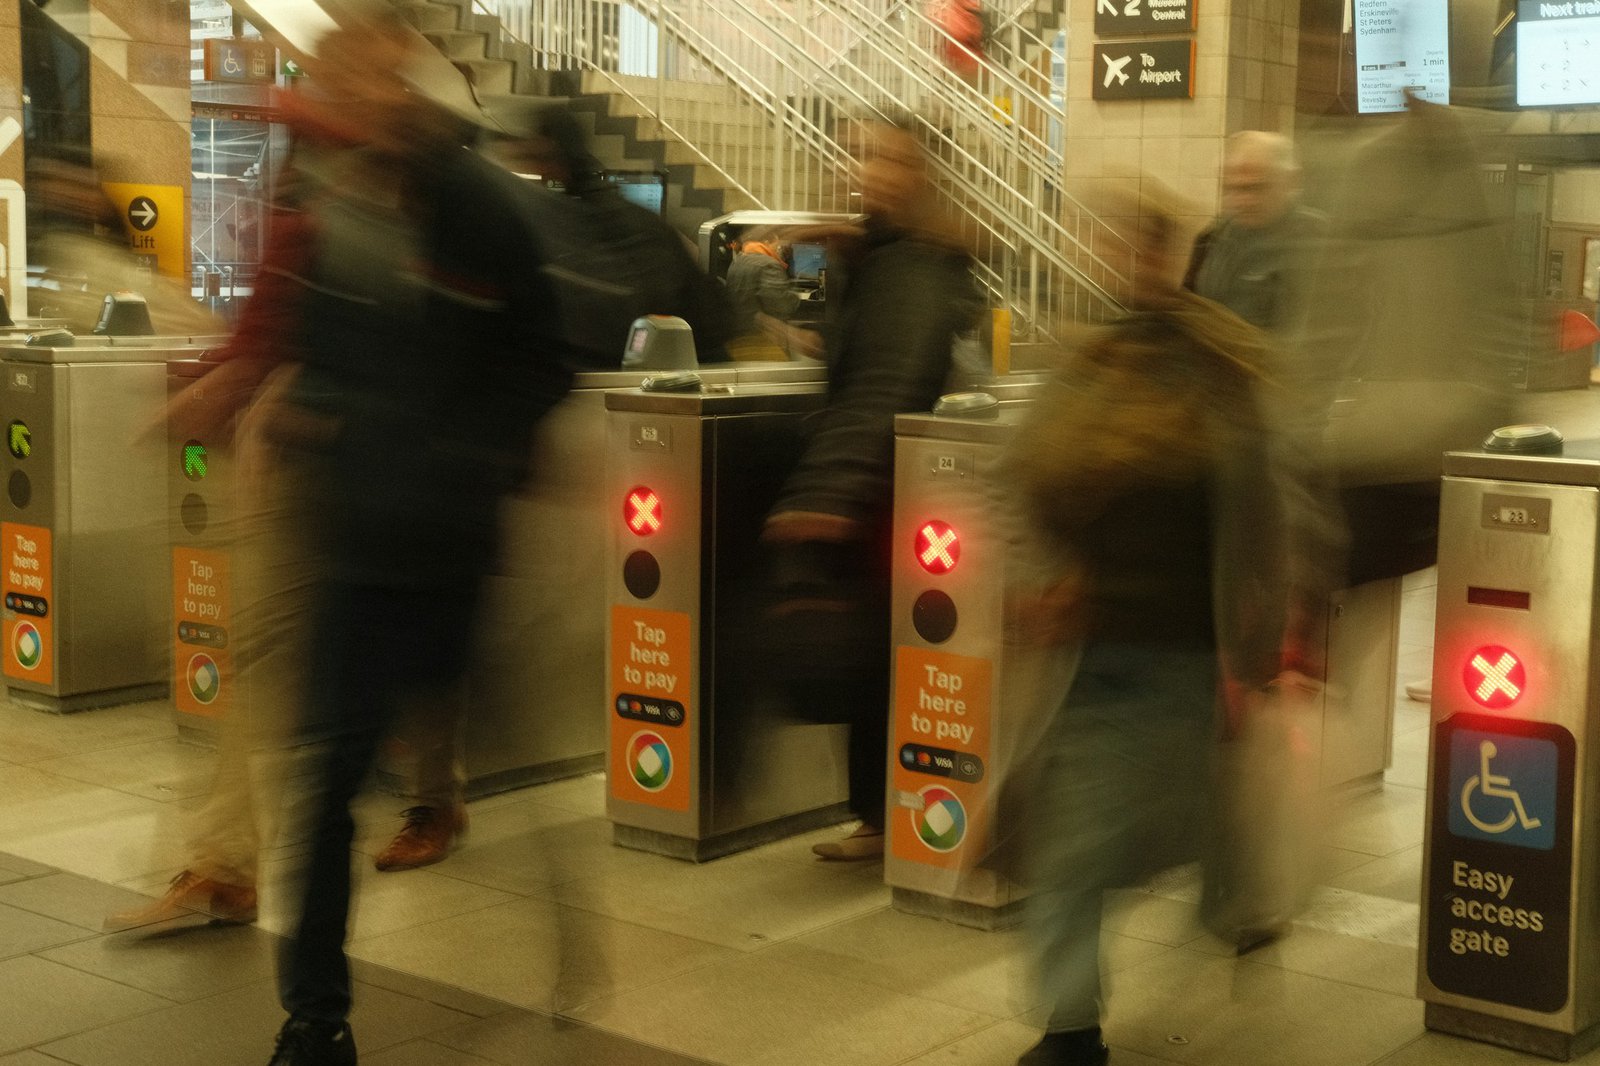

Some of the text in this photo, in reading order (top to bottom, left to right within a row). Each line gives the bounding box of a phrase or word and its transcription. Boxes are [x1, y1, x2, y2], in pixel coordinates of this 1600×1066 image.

[1360, 0, 1387, 8] Redfern
[1360, 8, 1399, 17] Erskineville
[1540, 2, 1573, 17] Next
[1152, 9, 1186, 20] Central
[1369, 18, 1392, 26] Peters
[1360, 27, 1397, 36] Sydenham
[1140, 53, 1155, 66] To
[1430, 58, 1445, 66] min
[1140, 69, 1181, 85] Airport
[132, 235, 156, 249] Lift
[941, 458, 952, 468] 24
[1510, 511, 1524, 523] 23
[15, 534, 37, 554] Tap
[12, 551, 40, 571] here
[190, 560, 213, 581] Tap
[9, 569, 44, 592] to pay
[188, 578, 216, 597] here
[183, 598, 221, 620] to pay
[633, 620, 666, 647] Tap
[630, 641, 670, 667] here
[623, 664, 677, 694] to pay
[924, 664, 962, 694] Tap
[919, 687, 966, 716] here
[911, 711, 974, 745] to pay
[934, 755, 953, 769] VISA
[1452, 860, 1515, 900] Easy
[1450, 897, 1544, 932] access
[1449, 927, 1510, 957] gate
